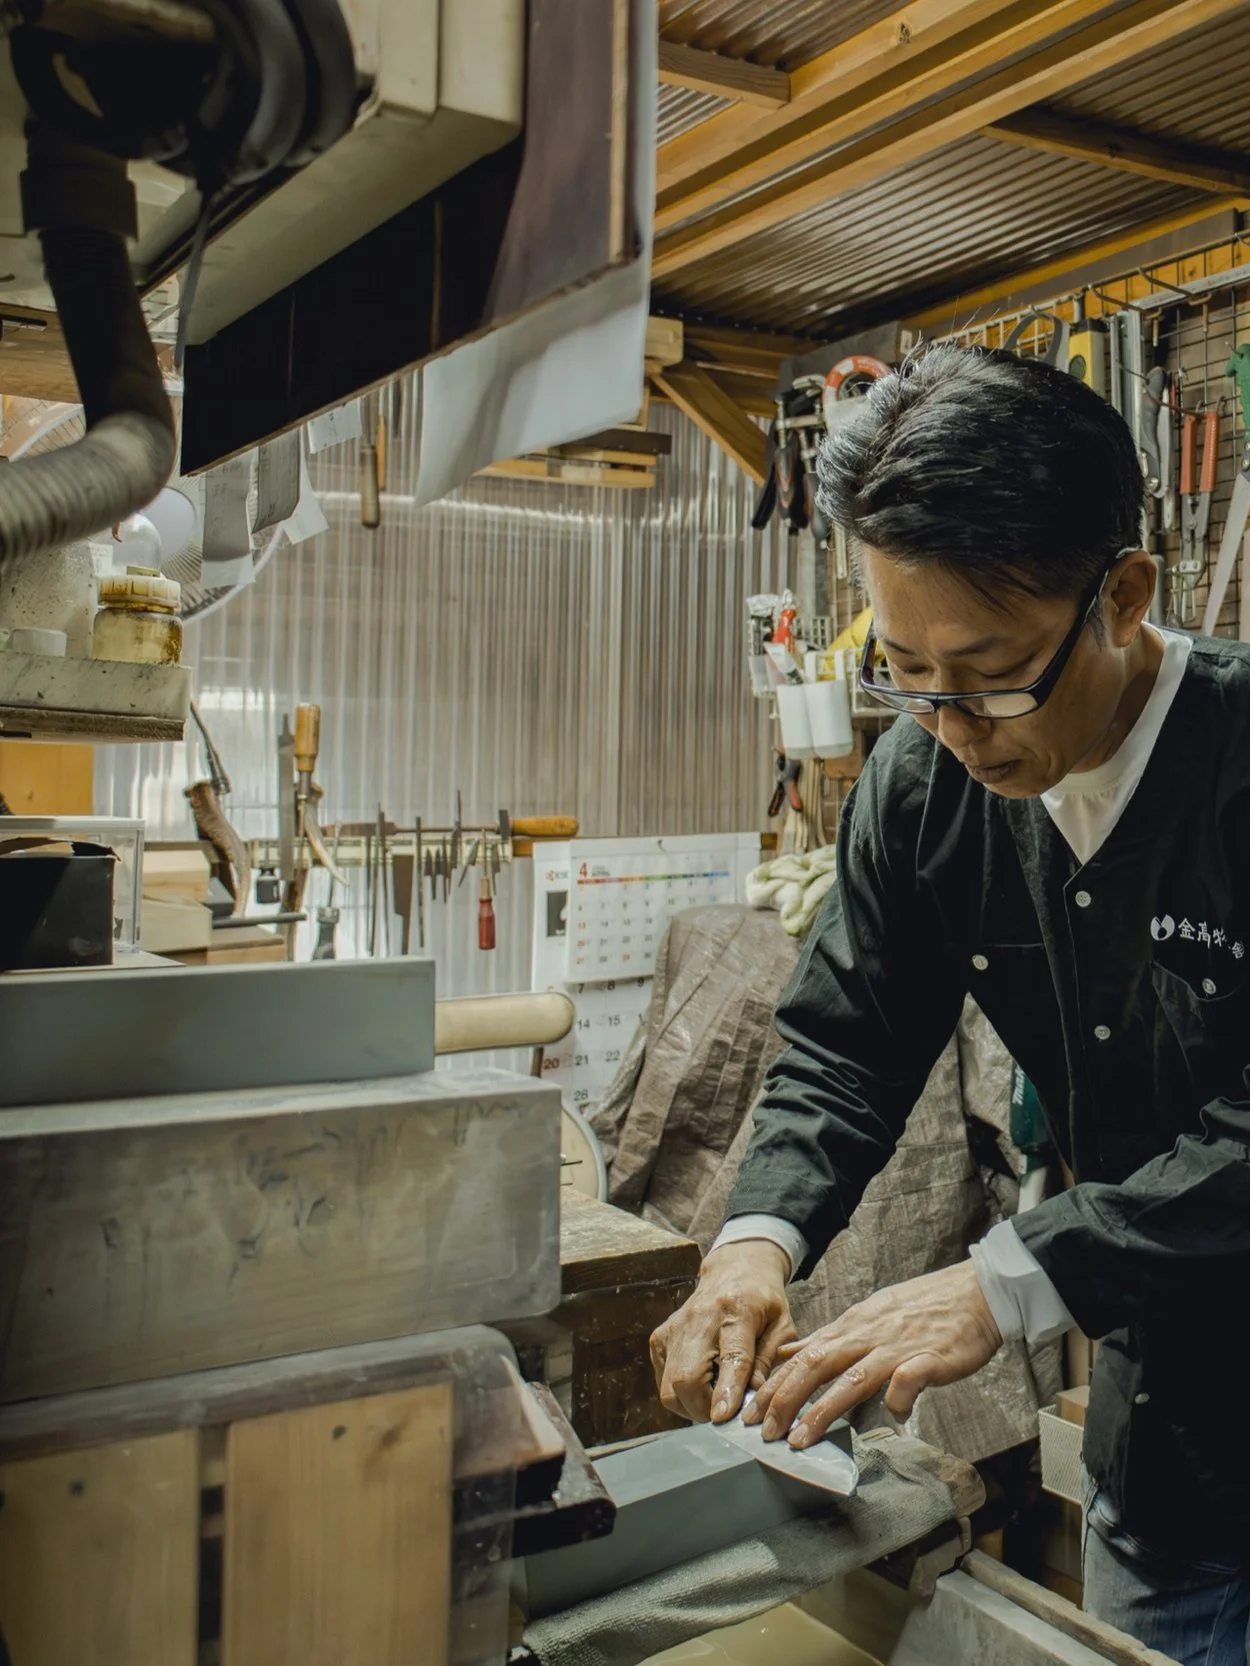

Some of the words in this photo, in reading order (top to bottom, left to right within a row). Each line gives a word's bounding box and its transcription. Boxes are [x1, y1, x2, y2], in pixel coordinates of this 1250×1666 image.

[579, 862, 588, 877] 4
[577, 983, 585, 994] 7
[607, 979, 616, 991] 8
[637, 976, 645, 988] 9
[578, 1019, 591, 1030] 14
[608, 1015, 621, 1026] 15
[543, 1058, 560, 1069] 20
[575, 1055, 589, 1067] 21
[605, 1050, 620, 1062] 22
[573, 1089, 589, 1102] 28
